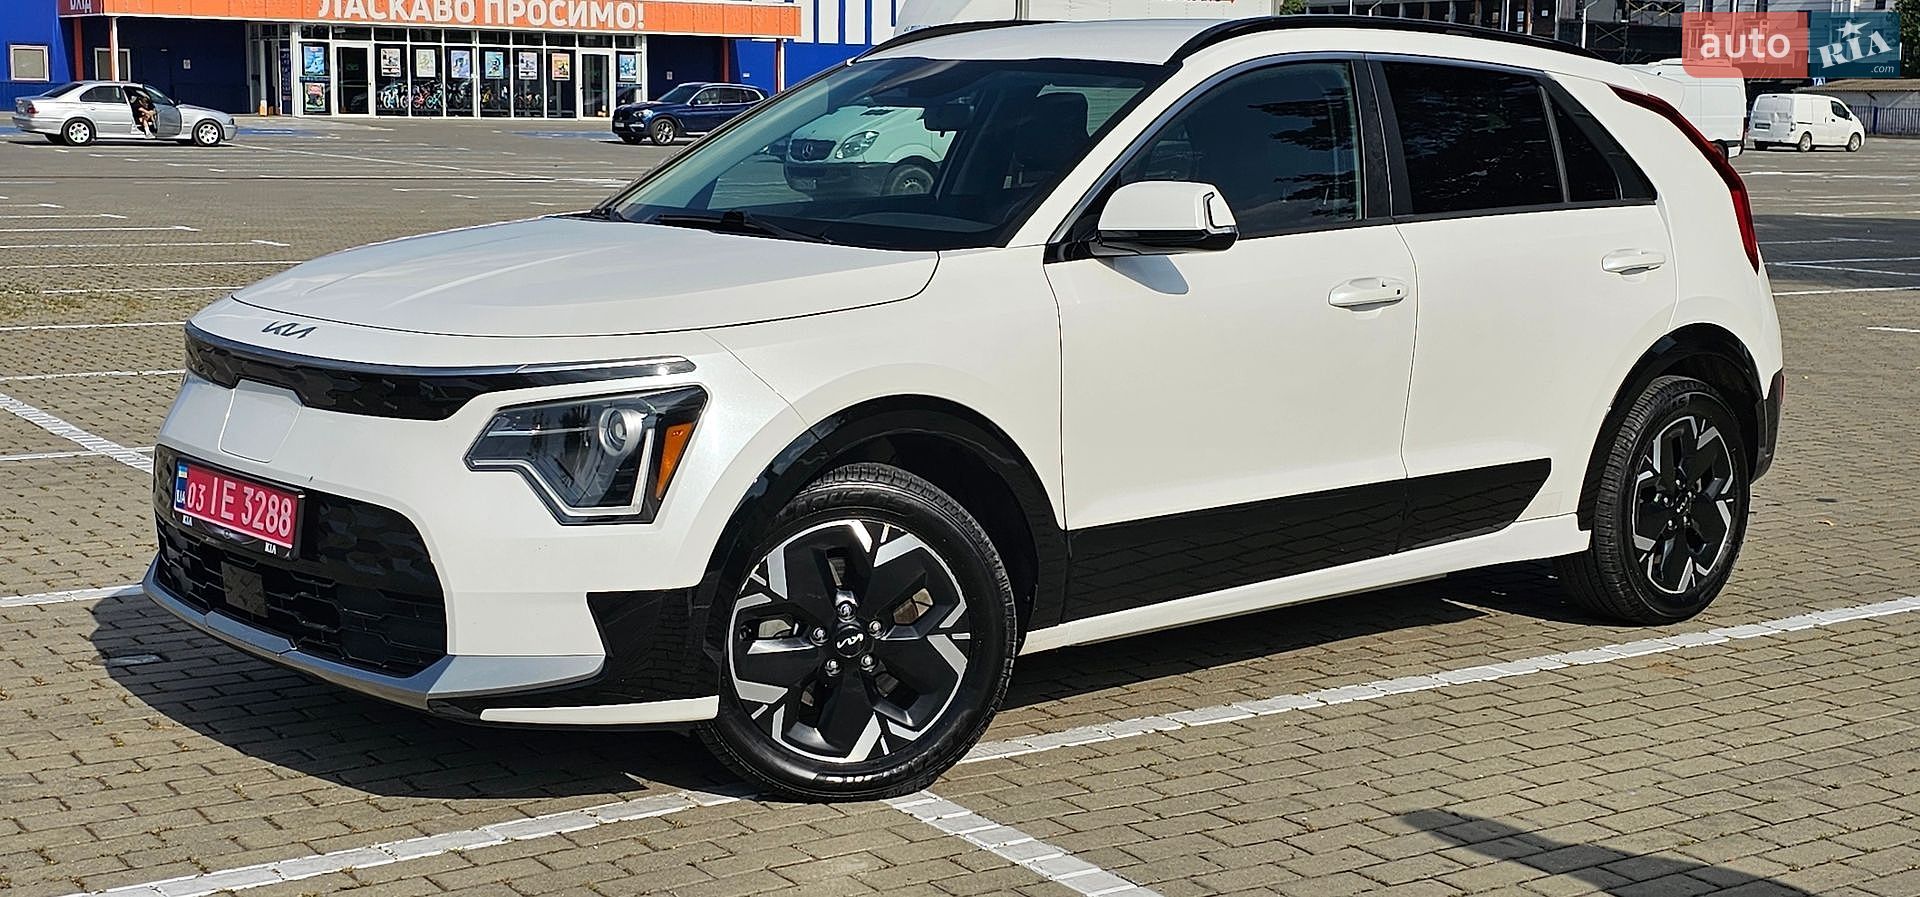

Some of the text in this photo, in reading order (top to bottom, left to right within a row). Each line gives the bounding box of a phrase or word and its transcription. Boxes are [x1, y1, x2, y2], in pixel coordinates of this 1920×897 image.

[318, 0, 645, 29] ЛАСКАВО ПРОСИМО!
[176, 489, 186, 505] UA
[187, 482, 206, 511] 03
[241, 486, 292, 537] 3288
[182, 514, 193, 527] KIA
[264, 541, 277, 555] KIA
